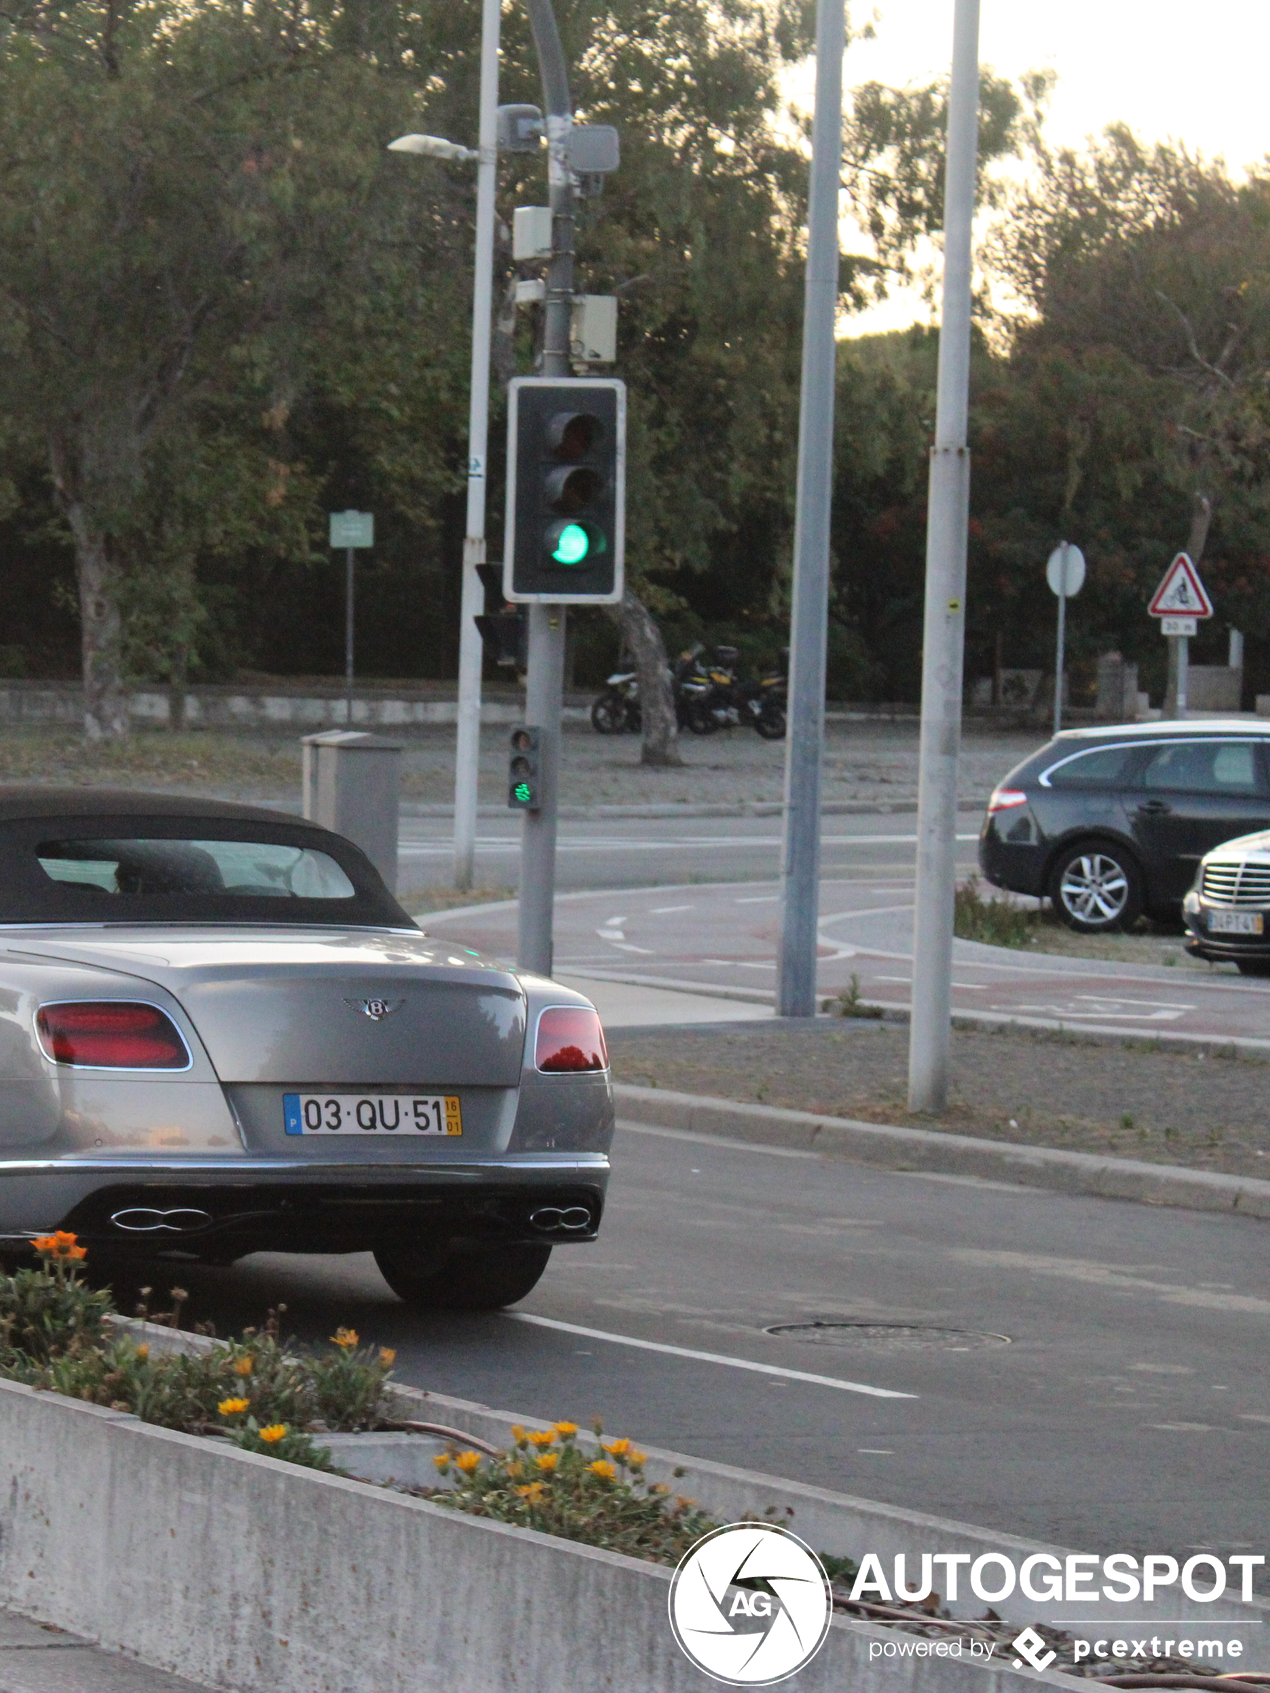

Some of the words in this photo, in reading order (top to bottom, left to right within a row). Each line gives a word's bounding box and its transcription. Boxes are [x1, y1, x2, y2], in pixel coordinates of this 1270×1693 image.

[445, 1101, 457, 1112] 16
[290, 1118, 297, 1128] P
[446, 1121, 459, 1132] 01
